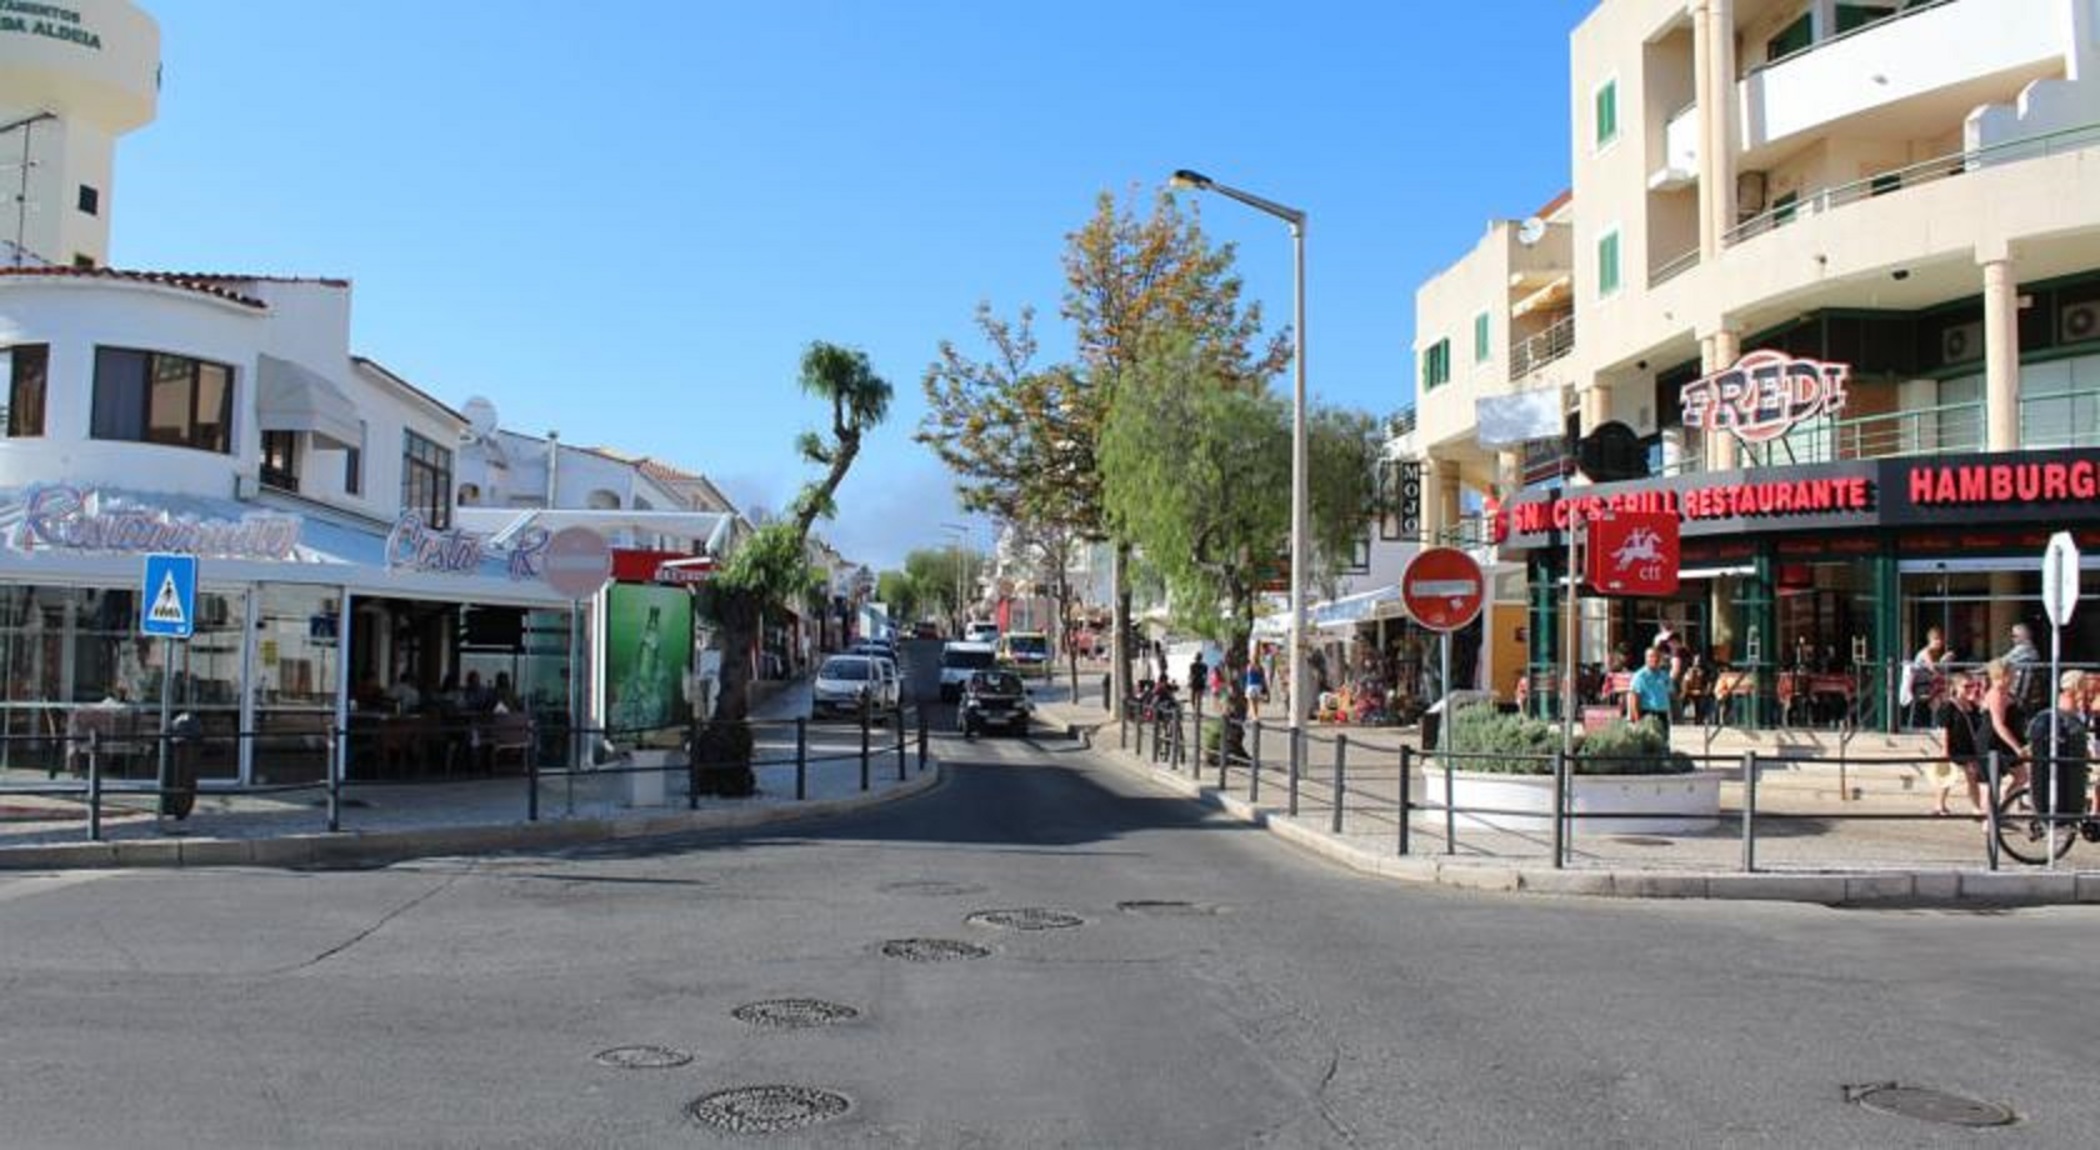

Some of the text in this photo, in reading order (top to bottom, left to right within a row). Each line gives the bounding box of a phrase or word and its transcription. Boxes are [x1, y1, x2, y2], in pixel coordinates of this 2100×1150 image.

[32, 21, 101, 50] ALDEIA
[1680, 361, 1851, 431] FREDI
[1404, 464, 1419, 535] MOJO
[1684, 478, 1868, 520] RESTAURANTE
[1910, 460, 2100, 504] HAMBURG
